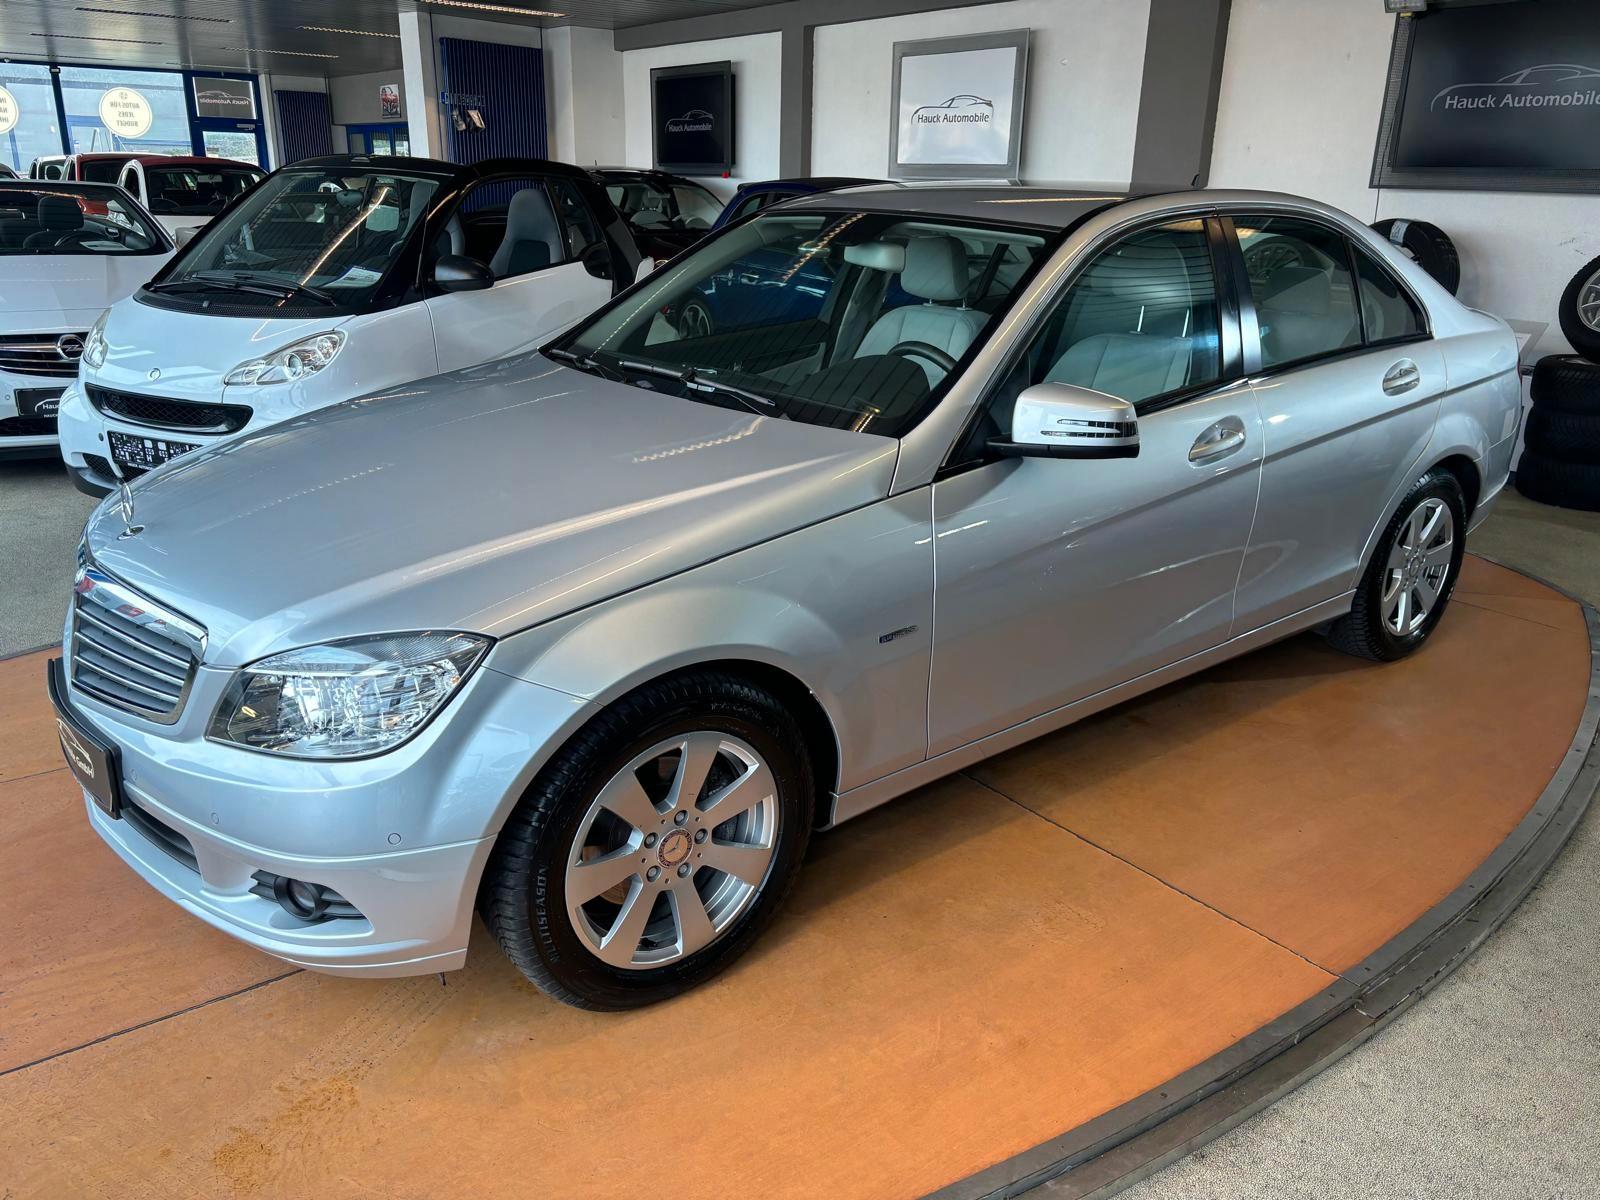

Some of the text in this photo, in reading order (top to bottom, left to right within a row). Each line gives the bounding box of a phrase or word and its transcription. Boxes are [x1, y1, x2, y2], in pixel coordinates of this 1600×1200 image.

[1444, 94, 1496, 109] Hauck
[917, 112, 990, 124] Hauck Automobile
